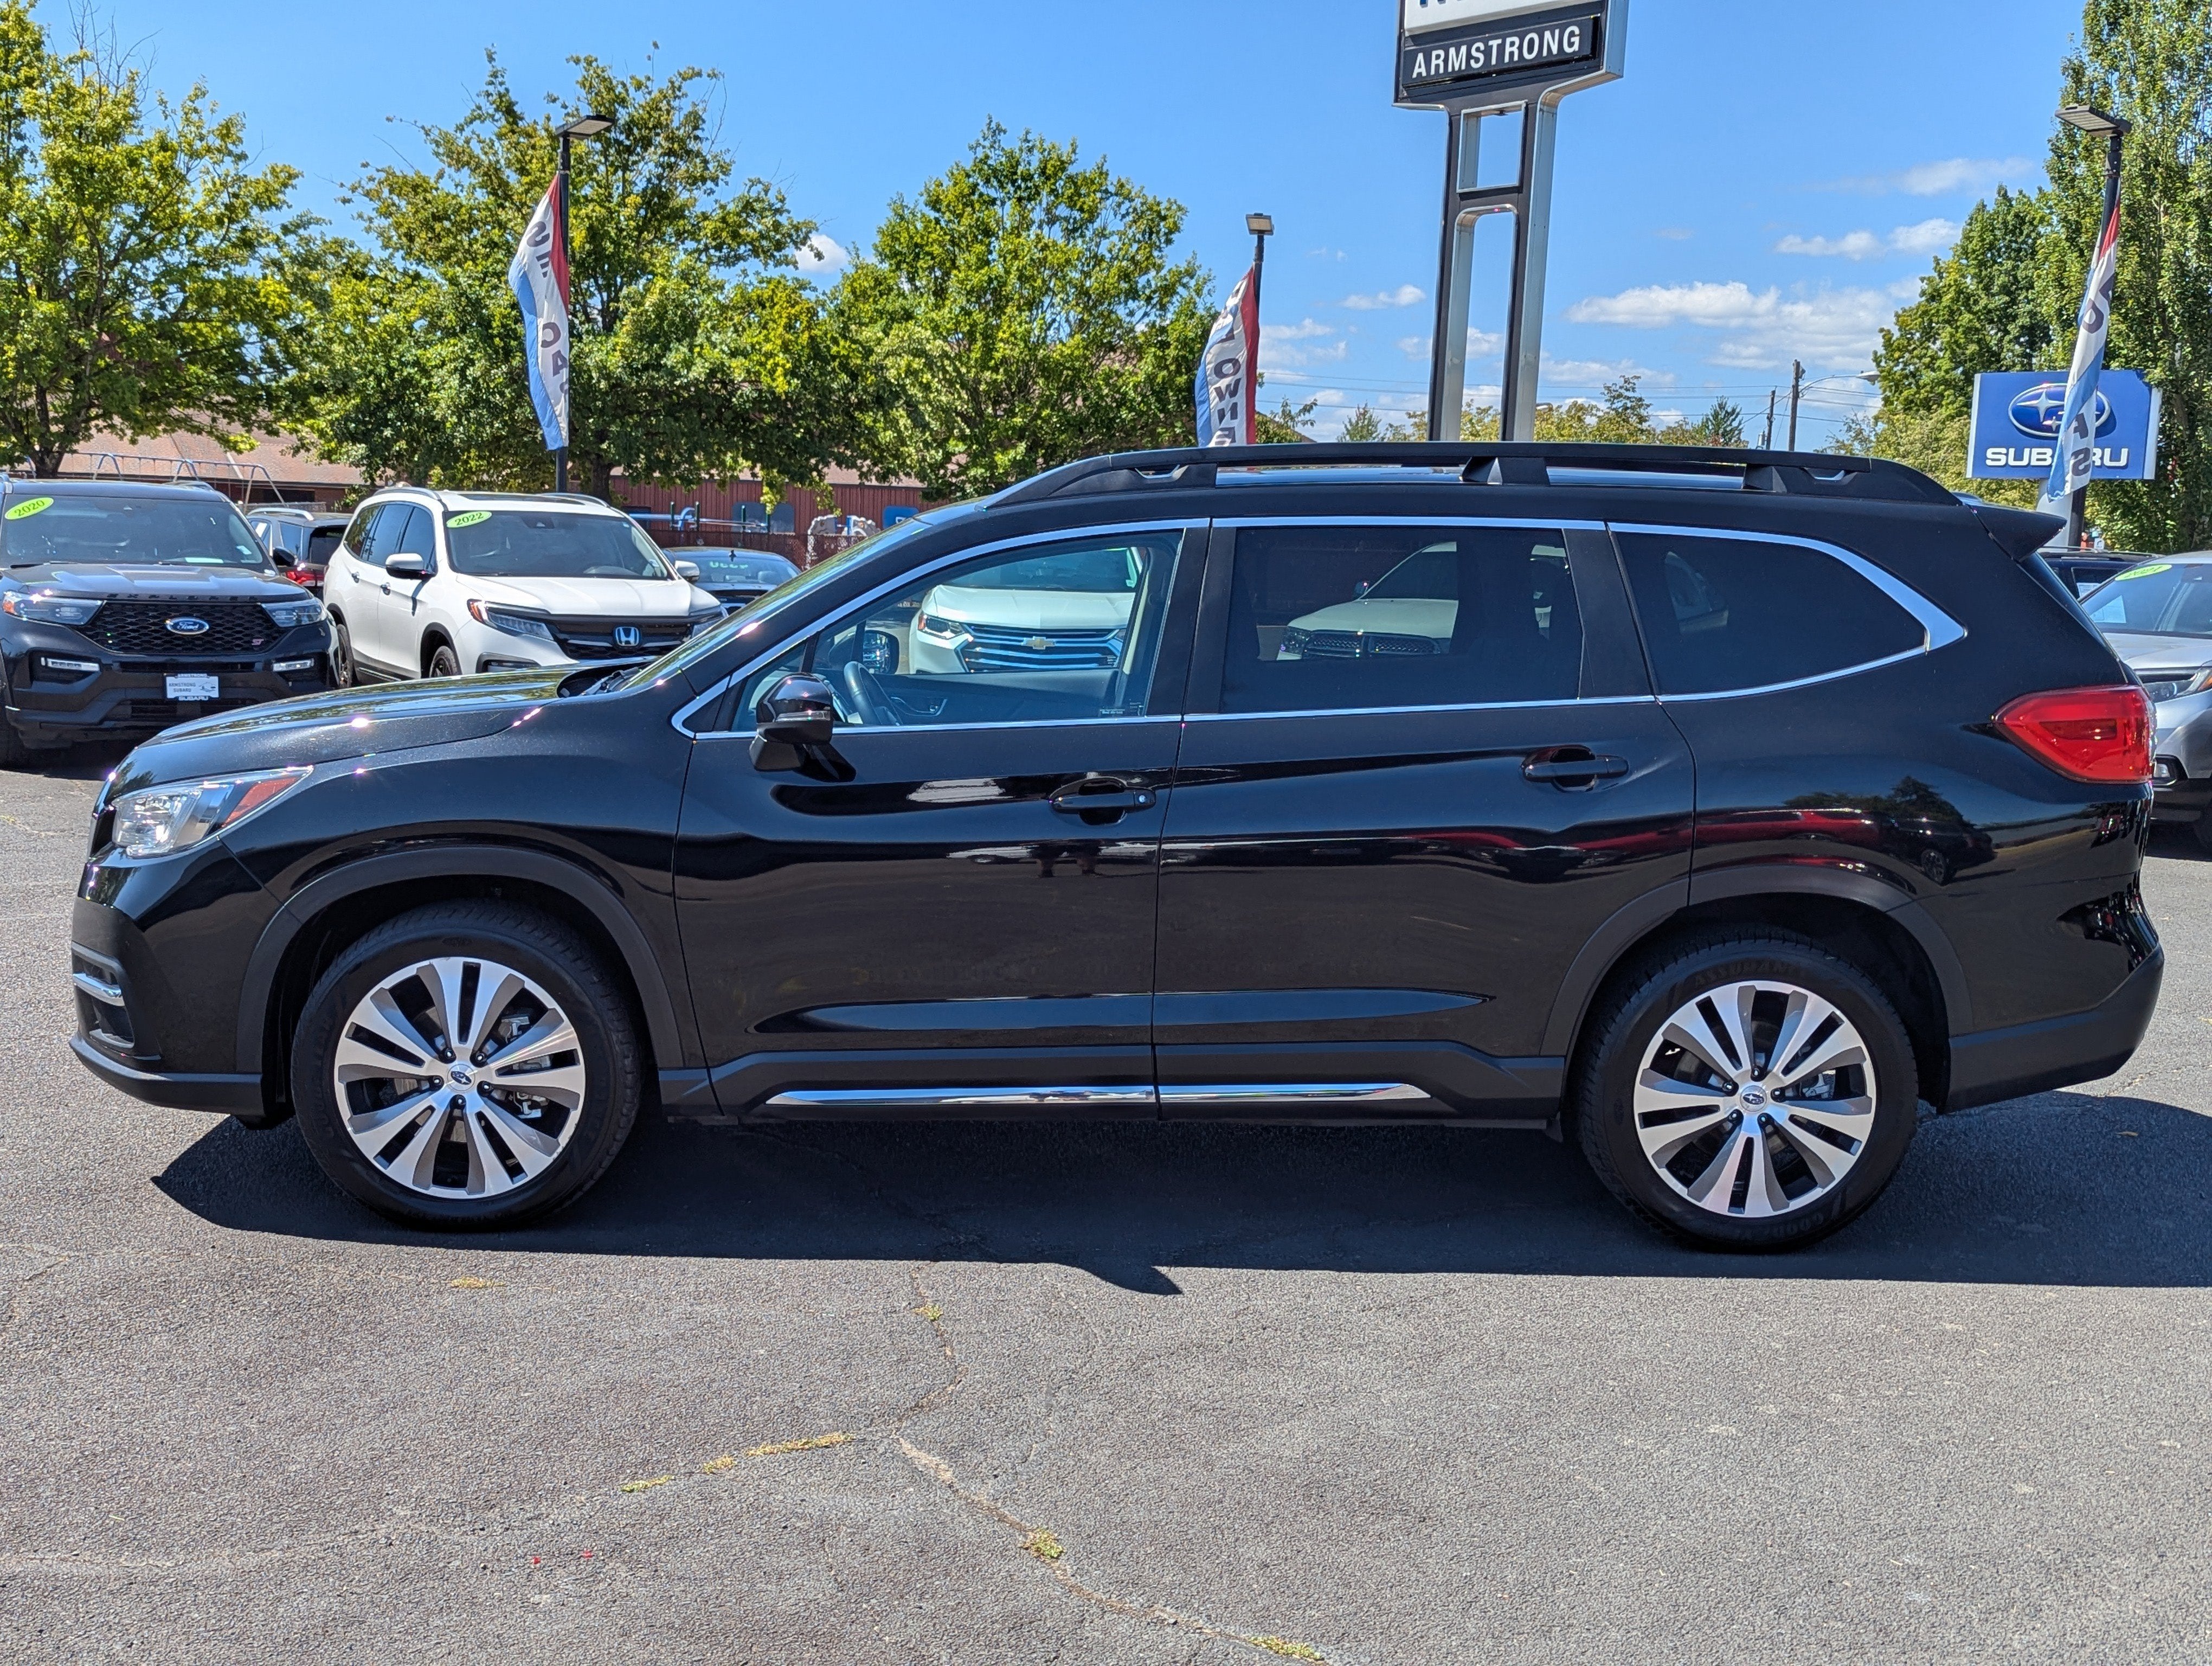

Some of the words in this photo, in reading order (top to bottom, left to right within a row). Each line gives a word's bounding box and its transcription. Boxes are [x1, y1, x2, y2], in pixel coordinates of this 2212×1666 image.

[1412, 25, 1580, 79] ARMSTRONG
[1985, 447, 2129, 467] SUBRU
[14, 500, 45, 517] 2020
[455, 512, 484, 526] 2022
